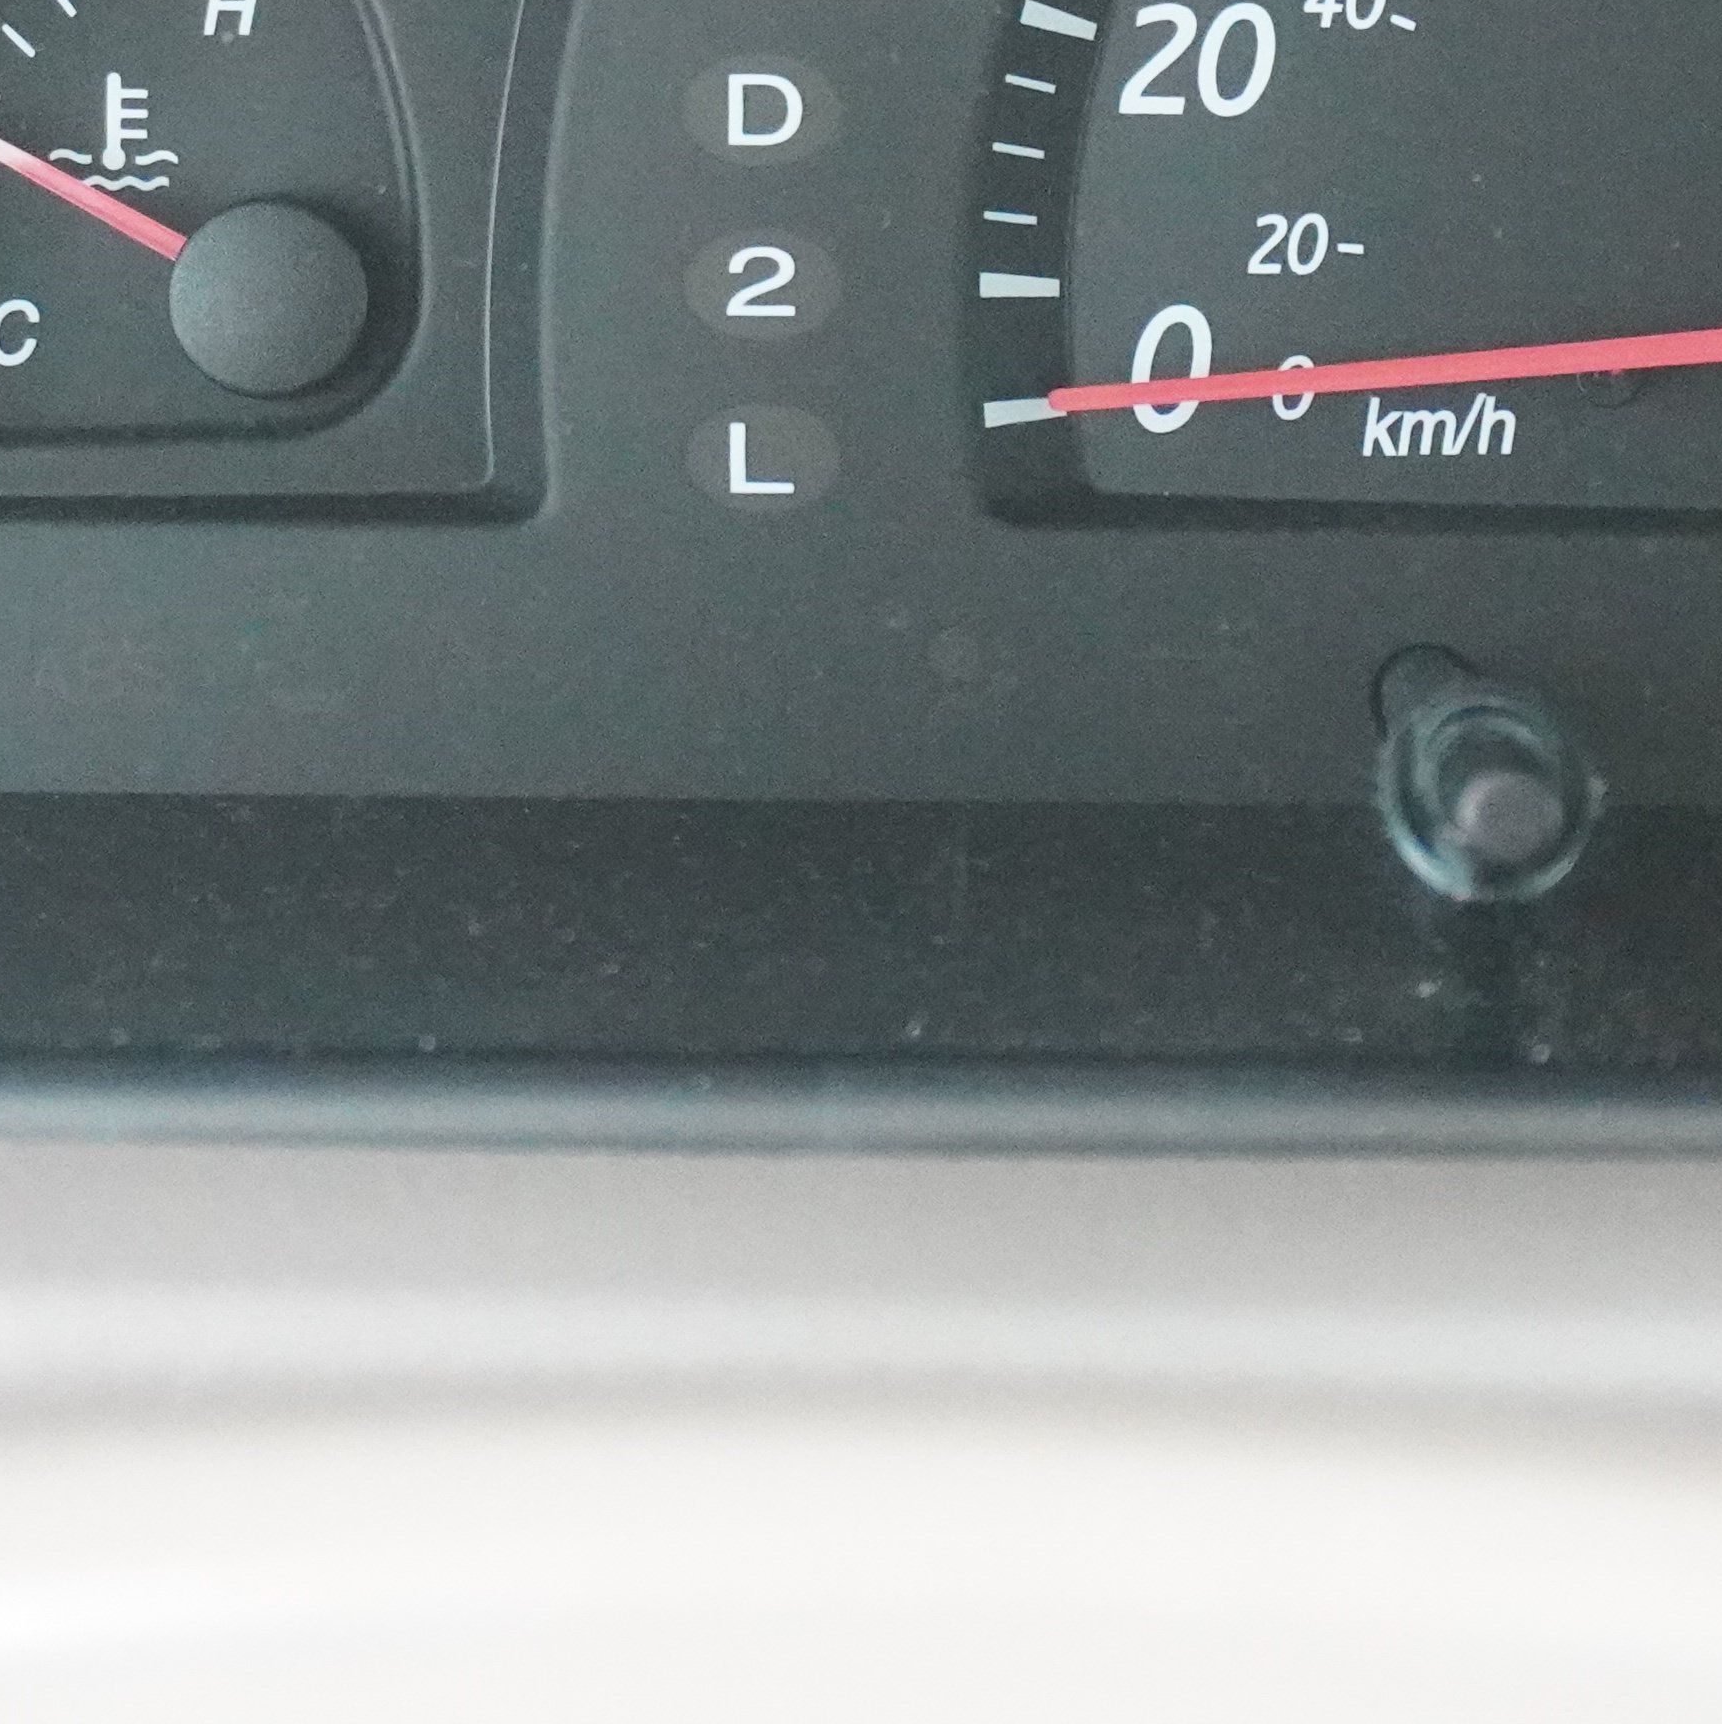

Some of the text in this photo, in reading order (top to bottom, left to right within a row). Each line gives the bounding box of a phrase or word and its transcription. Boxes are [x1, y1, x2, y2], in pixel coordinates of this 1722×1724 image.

[1119, 3, 1275, 117] 20
[728, 74, 802, 145] D
[1248, 213, 1328, 275] 20
[726, 247, 795, 316] 2
[1132, 305, 1212, 433] 0
[729, 423, 794, 493] L
[1363, 393, 1515, 456] km/h
